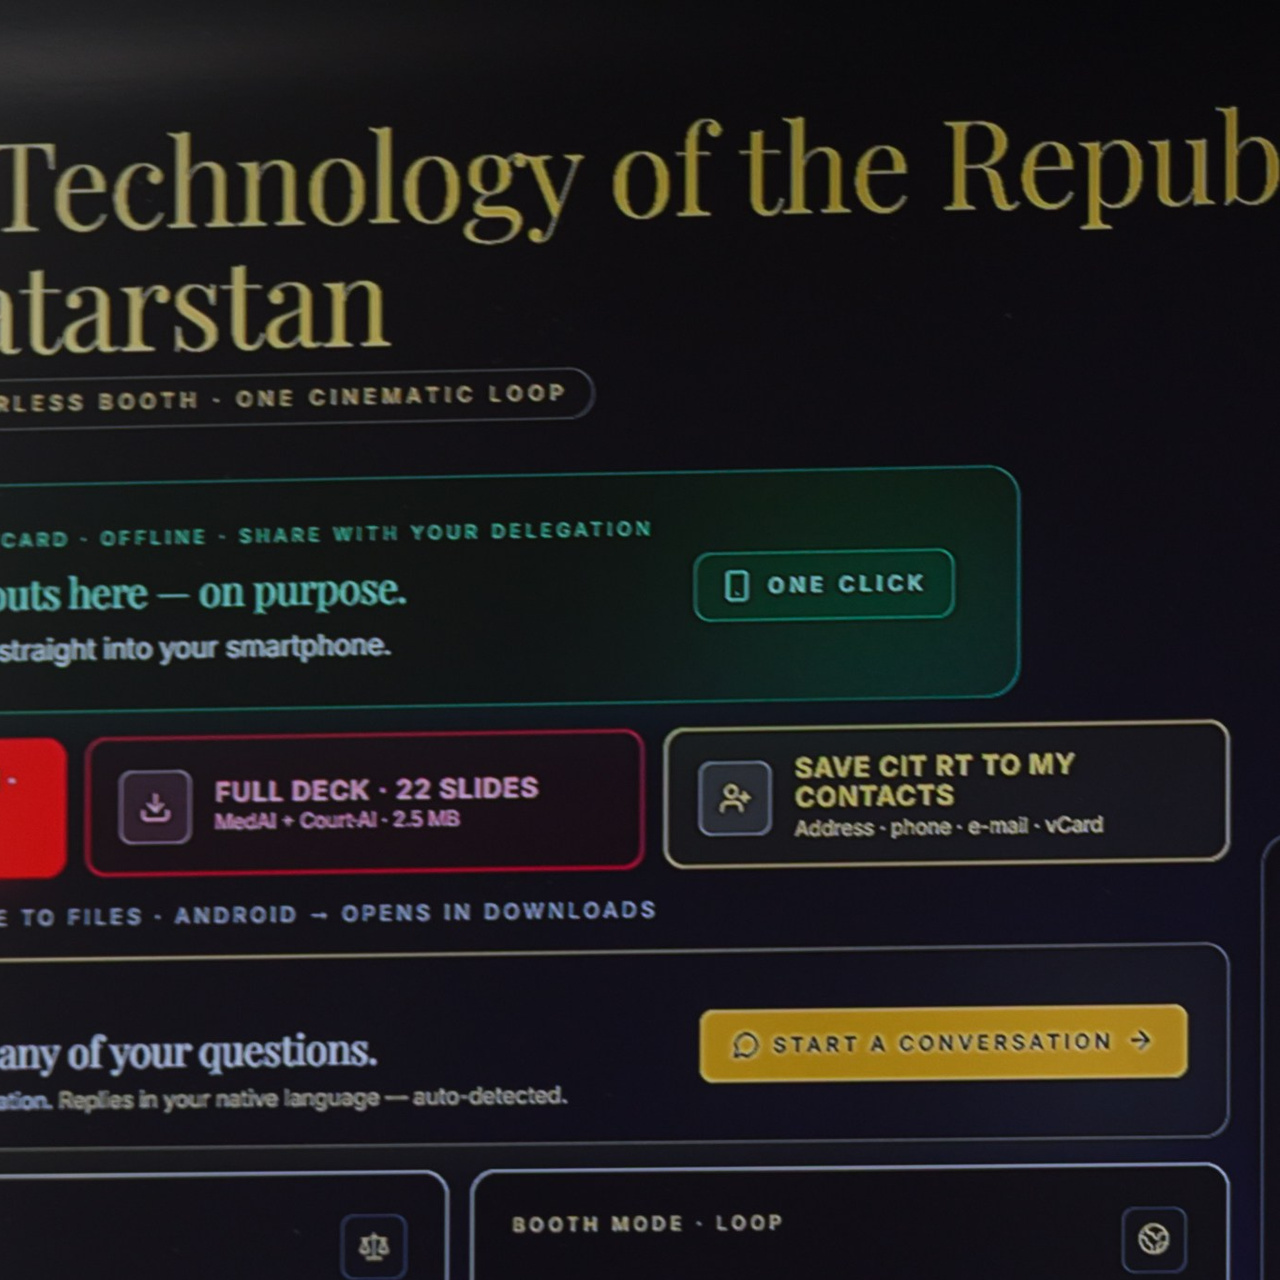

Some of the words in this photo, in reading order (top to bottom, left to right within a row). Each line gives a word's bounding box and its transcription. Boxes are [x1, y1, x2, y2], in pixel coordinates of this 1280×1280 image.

[612, 118, 723, 219] of
[739, 116, 908, 216] the
[98, 391, 197, 411] BOOTH
[235, 389, 293, 408] ONE
[308, 384, 473, 406] CINEMATIC
[488, 383, 565, 402] LOOP
[99, 529, 205, 546] OFFLINE
[238, 526, 321, 544] SHARE
[332, 525, 398, 542] WITH
[410, 523, 478, 540] YOUR
[490, 520, 651, 539] DELEGATION
[67, 574, 149, 610] here
[198, 582, 246, 608] on
[253, 579, 407, 614] purpose.
[767, 575, 824, 594] ONE
[838, 573, 924, 593] CLICK
[102, 636, 154, 660] into
[158, 639, 220, 665] your
[225, 634, 392, 663] smartphone.
[795, 755, 870, 779] SAVE
[878, 755, 928, 777] CIT
[936, 754, 974, 776] RT
[981, 753, 1022, 775] TO
[1028, 752, 1076, 775] MY
[215, 780, 284, 803] FULL
[291, 779, 370, 801] DECK
[395, 777, 431, 800] 22
[439, 776, 540, 799] SLIDES
[794, 783, 955, 808] CONTACTS
[793, 819, 876, 837] Address
[890, 818, 953, 839] phone
[967, 816, 1029, 835] e-mail
[1044, 815, 1105, 834] vCard
[20, 908, 55, 926] TO
[67, 907, 142, 926] FILES
[174, 905, 297, 924] ANDROID
[341, 903, 431, 922] OPENS
[443, 902, 471, 921] IN
[483, 900, 656, 920] DOWNLOADS
[67, 1033, 108, 1070] of
[108, 1042, 194, 1077] your
[197, 1031, 378, 1075] questions.
[773, 1035, 859, 1054] START
[871, 1034, 887, 1053] A
[898, 1031, 1112, 1053] CONVERSATION
[512, 1216, 599, 1233] BOOTH
[611, 1215, 682, 1232] MODE
[716, 1214, 783, 1231] LOOP
